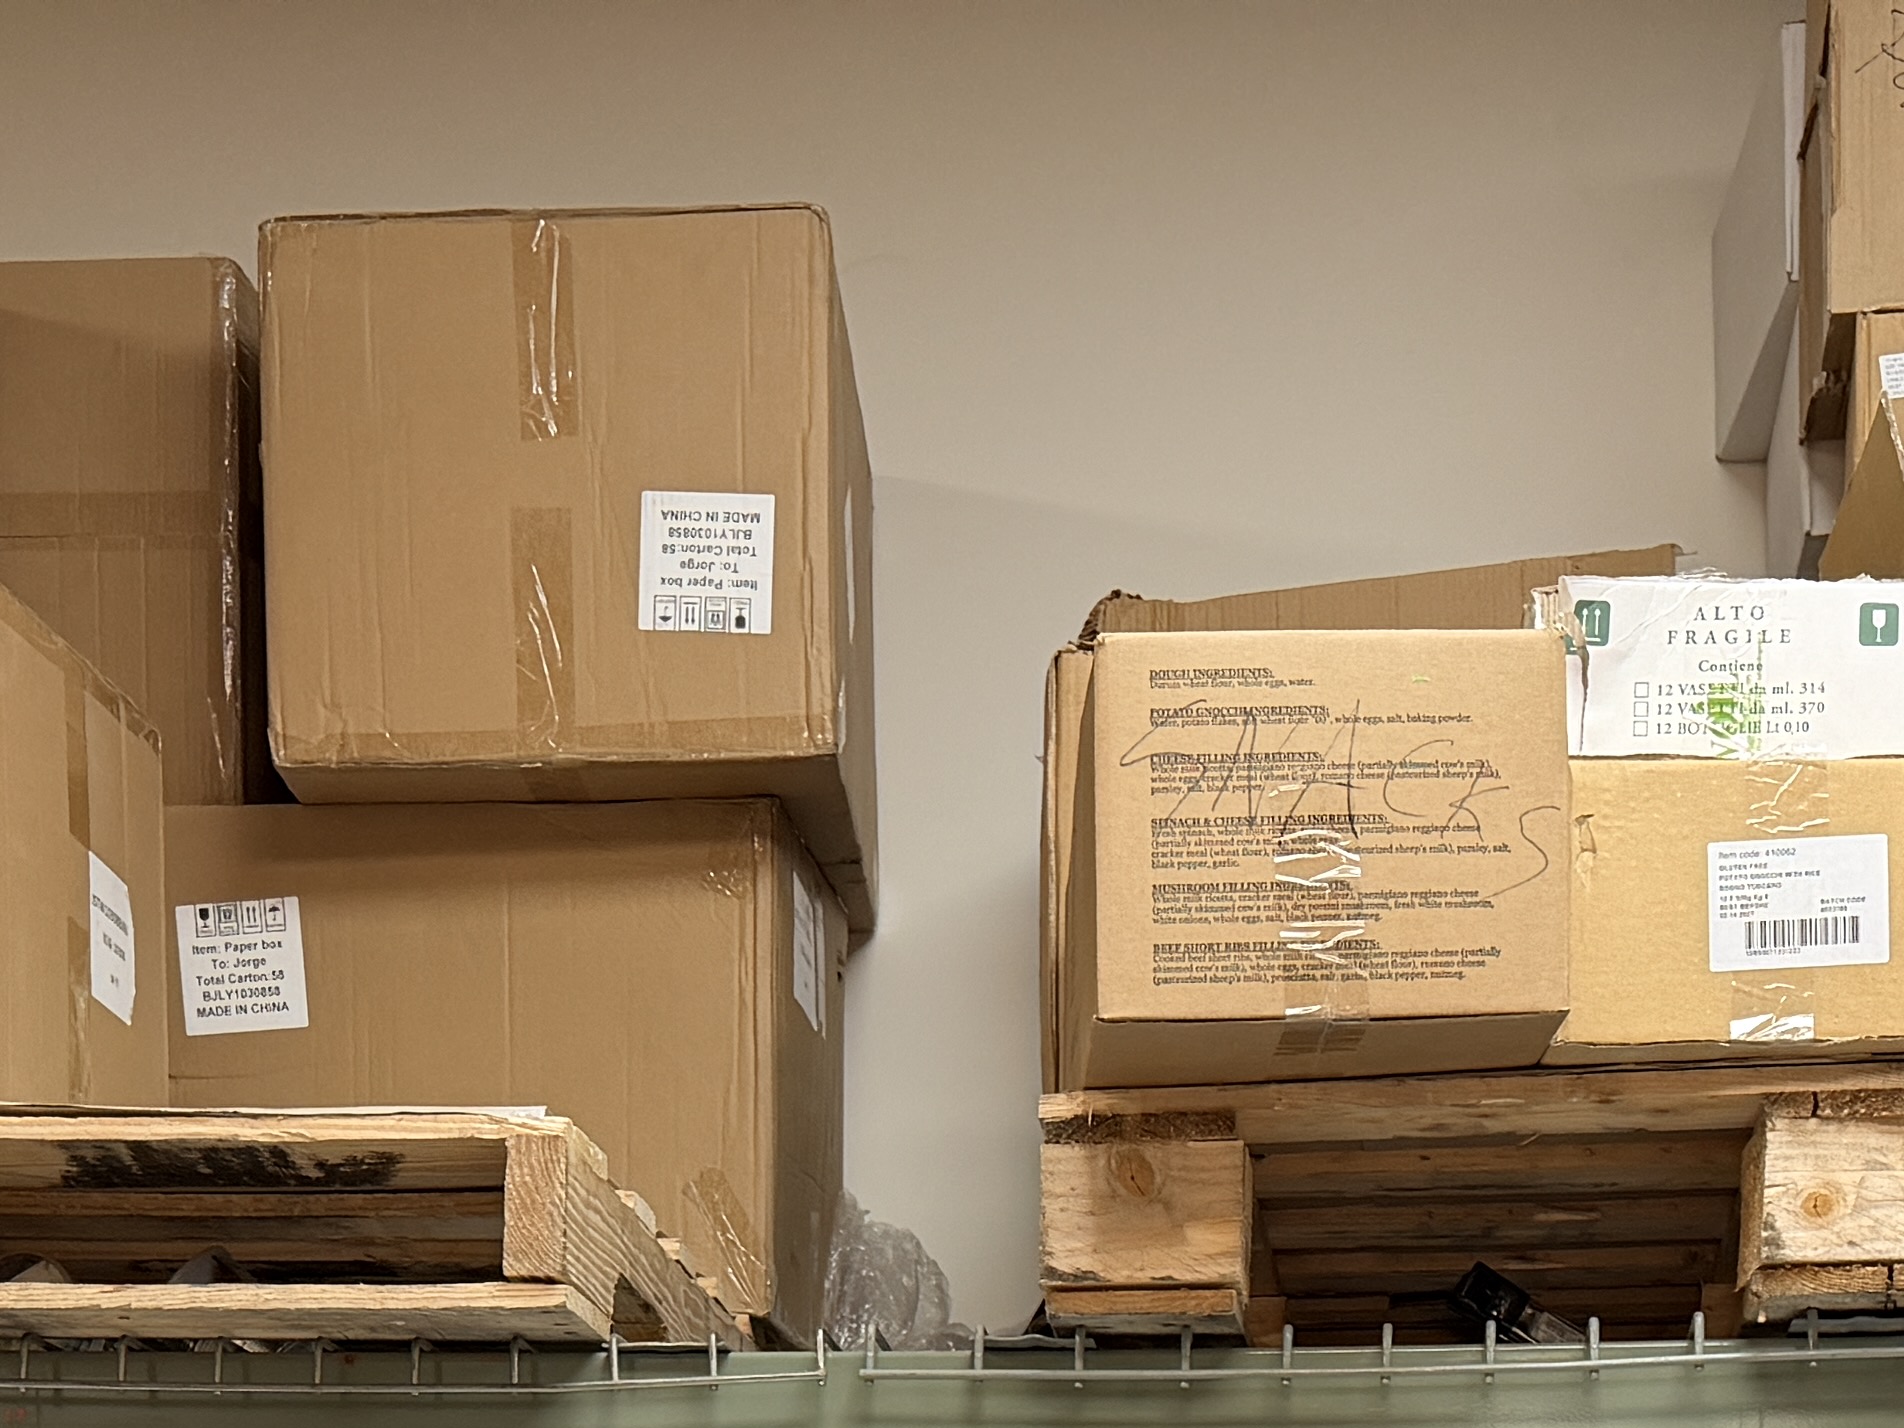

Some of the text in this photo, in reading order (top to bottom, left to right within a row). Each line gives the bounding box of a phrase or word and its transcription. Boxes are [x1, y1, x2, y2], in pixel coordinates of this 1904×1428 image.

[661, 510, 761, 523] MADE IN CHINA
[726, 545, 757, 557] Total
[680, 558, 739, 573] To: Jorge
[660, 576, 758, 591] Item: Paper box
[1694, 605, 1765, 621] ALTO
[1667, 629, 1792, 645] FRAGILE
[1698, 659, 1764, 672] Contiene
[1657, 683, 1673, 696] 12
[1771, 682, 1794, 694] ml.
[1799, 681, 1826, 694] 314
[1657, 702, 1673, 715] 12
[1749, 701, 1766, 714] da
[1771, 701, 1794, 714] ml.
[1799, 701, 1825, 713] 370
[1657, 722, 1672, 734] 12
[224, 941, 258, 954] Paper
[262, 940, 283, 950] box
[211, 957, 267, 969] To: Jorge
[196, 974, 225, 986] Total
[196, 1001, 289, 1018] MADE IN CHINA
